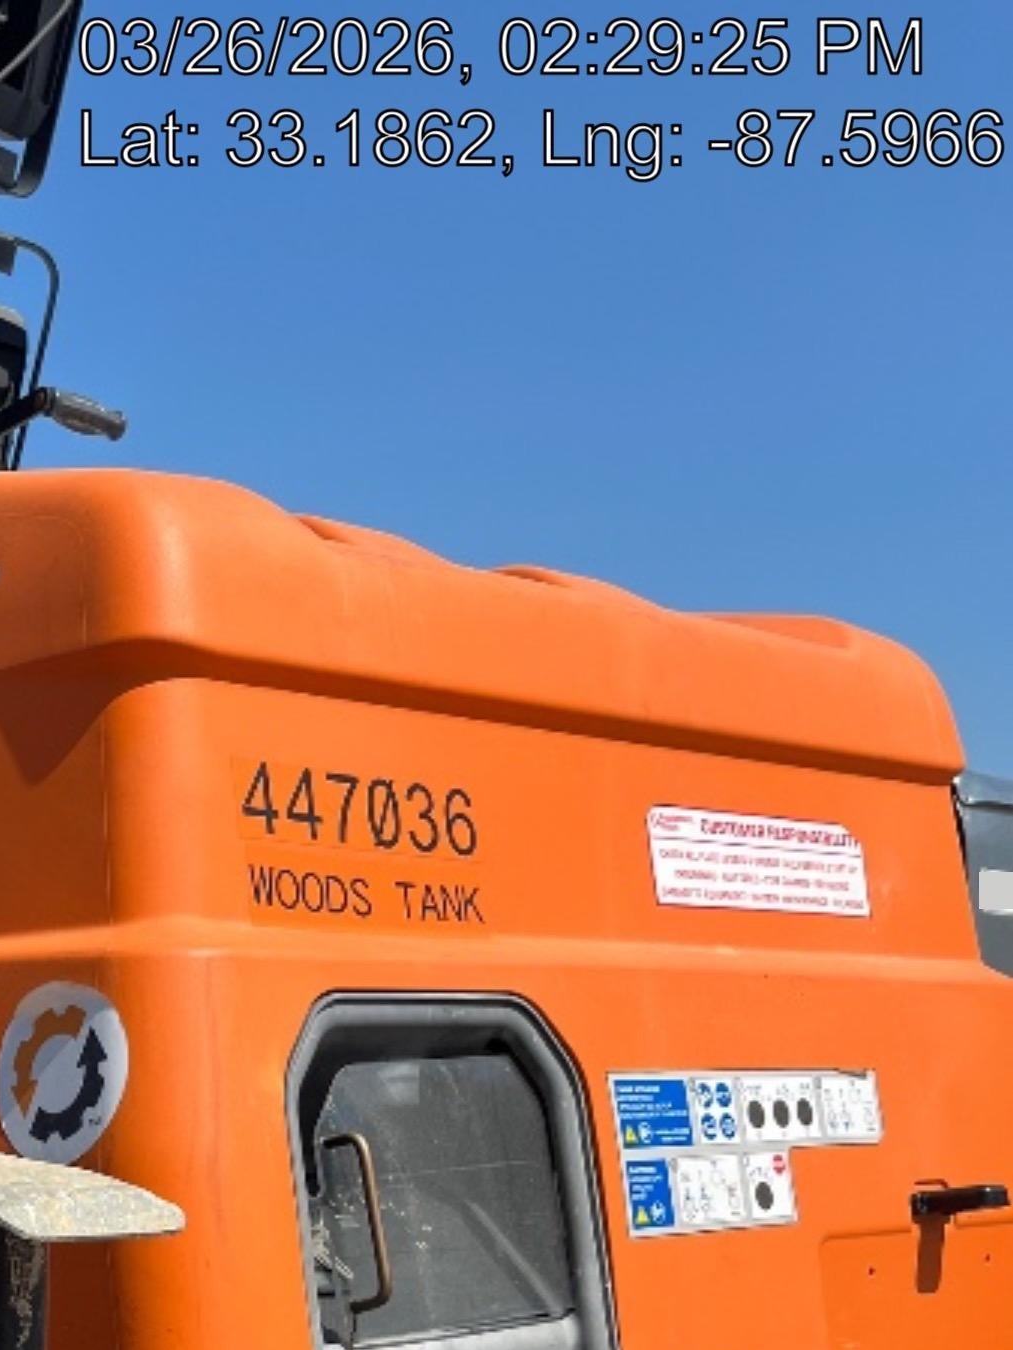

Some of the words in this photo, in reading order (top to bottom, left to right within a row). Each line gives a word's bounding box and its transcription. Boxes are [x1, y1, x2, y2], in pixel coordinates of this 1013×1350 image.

[242, 761, 477, 856] 447036
[248, 863, 372, 918] WOODS
[395, 880, 486, 924] TANK
